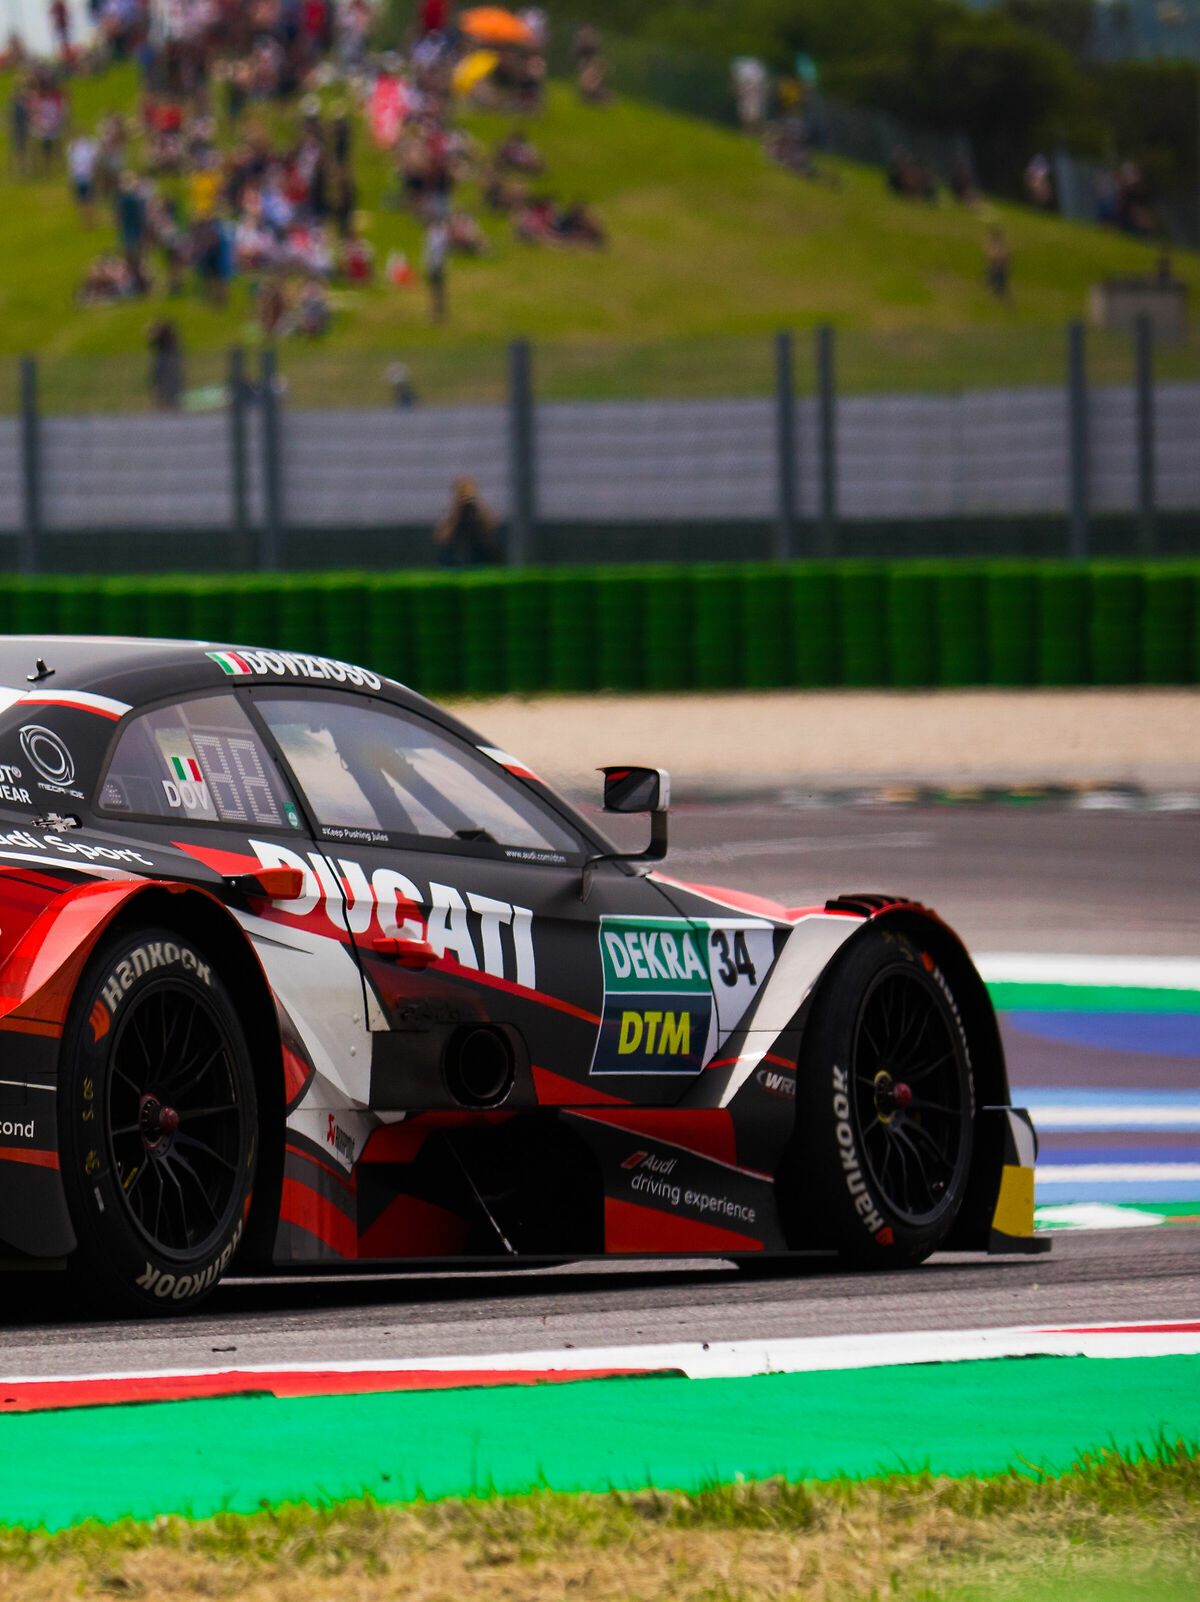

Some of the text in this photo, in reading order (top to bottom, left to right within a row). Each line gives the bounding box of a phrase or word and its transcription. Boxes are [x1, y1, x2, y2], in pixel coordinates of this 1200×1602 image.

[161, 779, 210, 810] DOV
[43, 834, 154, 866] Sport
[248, 839, 536, 991] DUCATI
[604, 931, 707, 981] DEKRA
[710, 929, 757, 987] 34
[618, 1011, 690, 1055] DTM
[641, 1153, 678, 1176] Audi
[631, 1174, 757, 1223] driving experience
